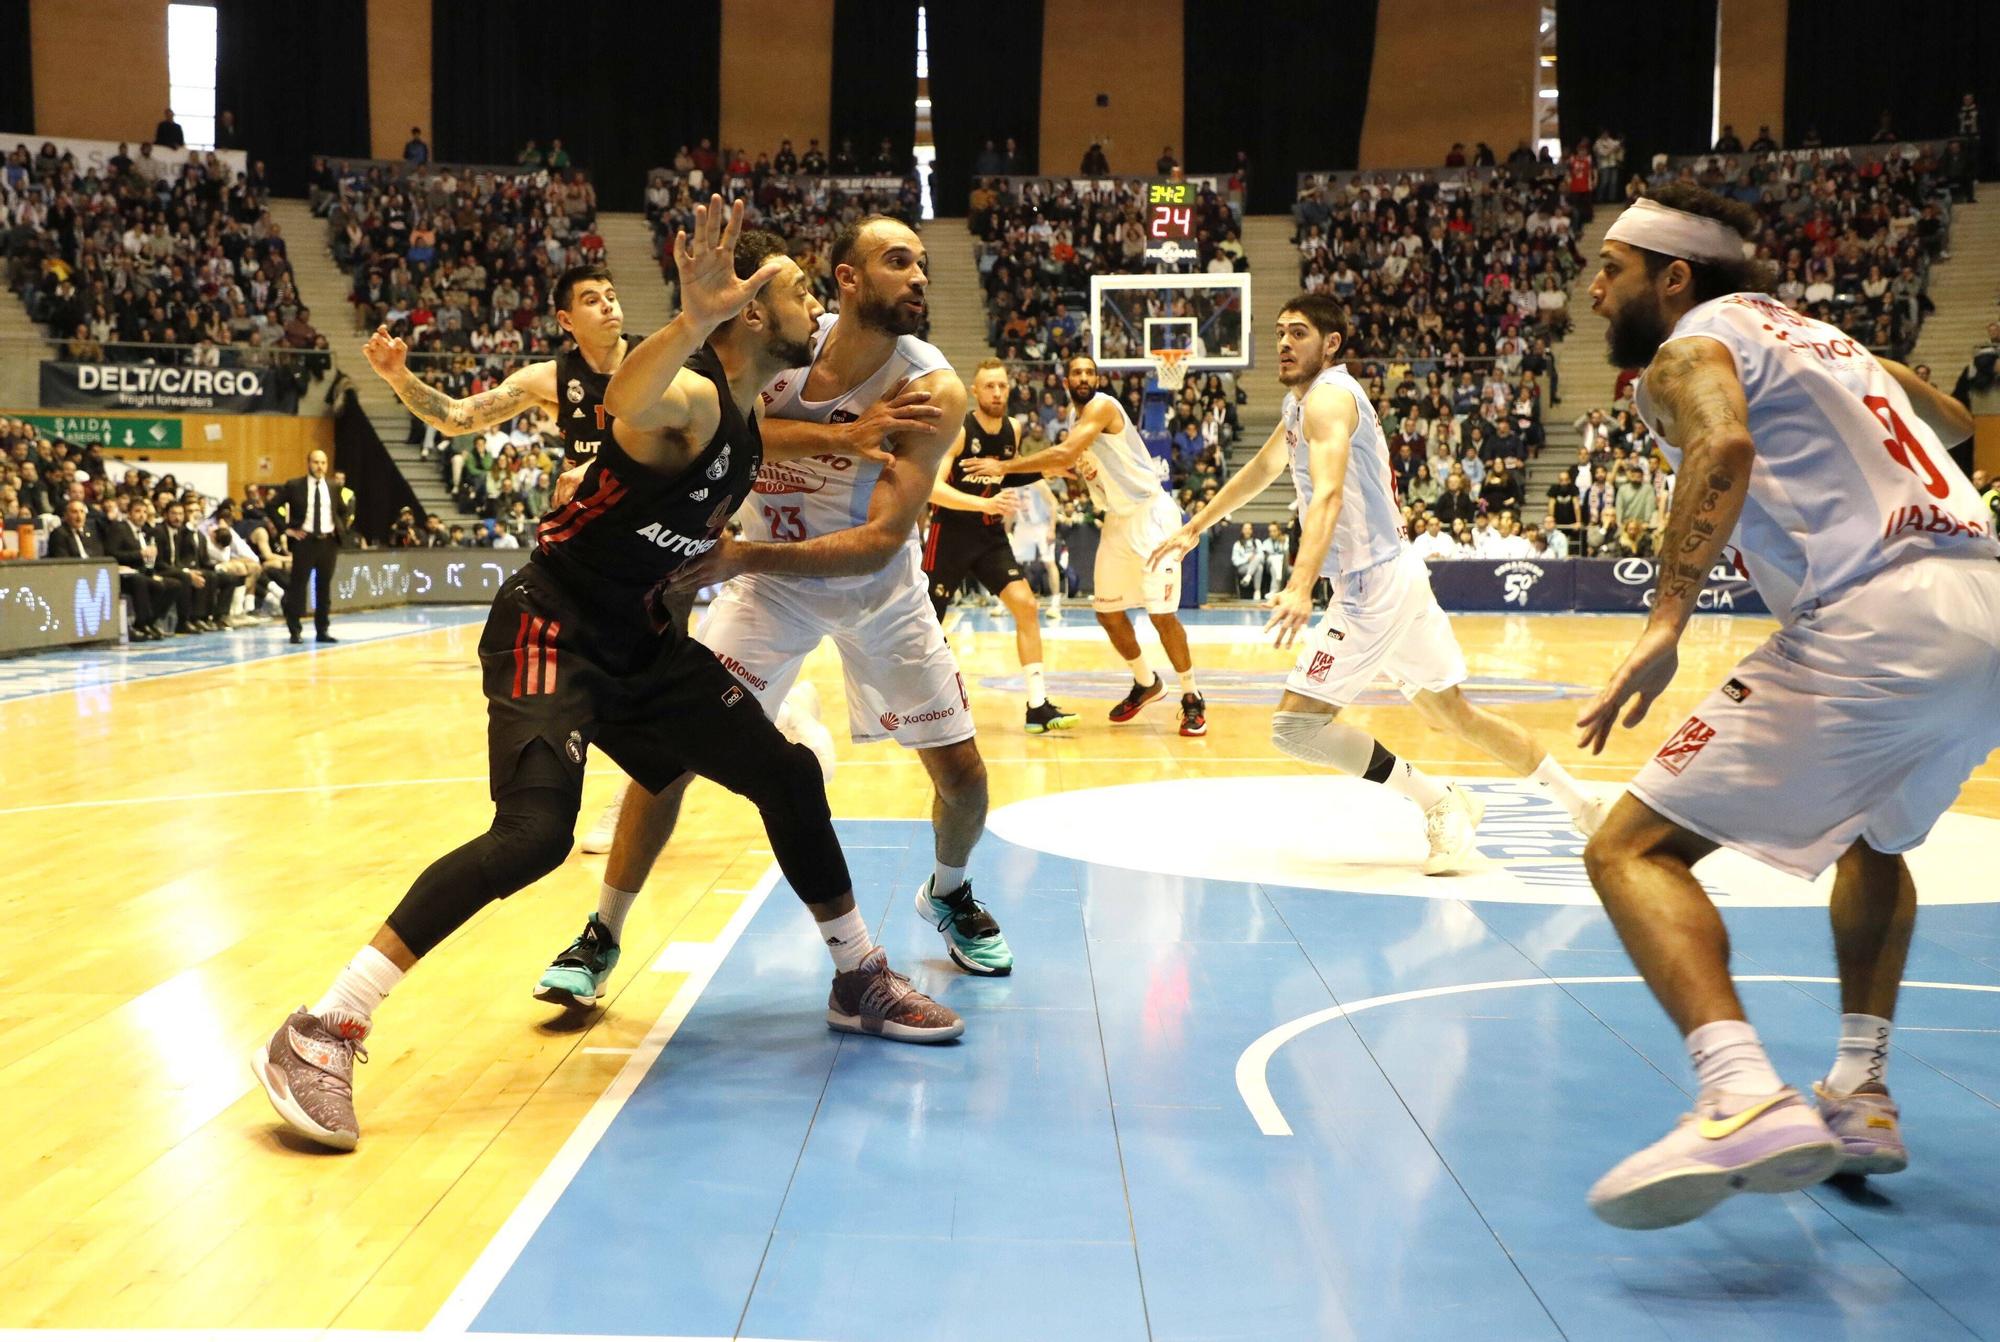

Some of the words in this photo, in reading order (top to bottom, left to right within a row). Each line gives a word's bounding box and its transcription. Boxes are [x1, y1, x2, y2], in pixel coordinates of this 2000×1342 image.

[1152, 206, 1191, 237] 24
[119, 394, 154, 408] freight
[156, 395, 213, 408] forwarders
[55, 418, 112, 431] SAIDA
[764, 505, 807, 541] 23
[727, 693, 740, 705] acb
[902, 707, 955, 726] Xacobeo
